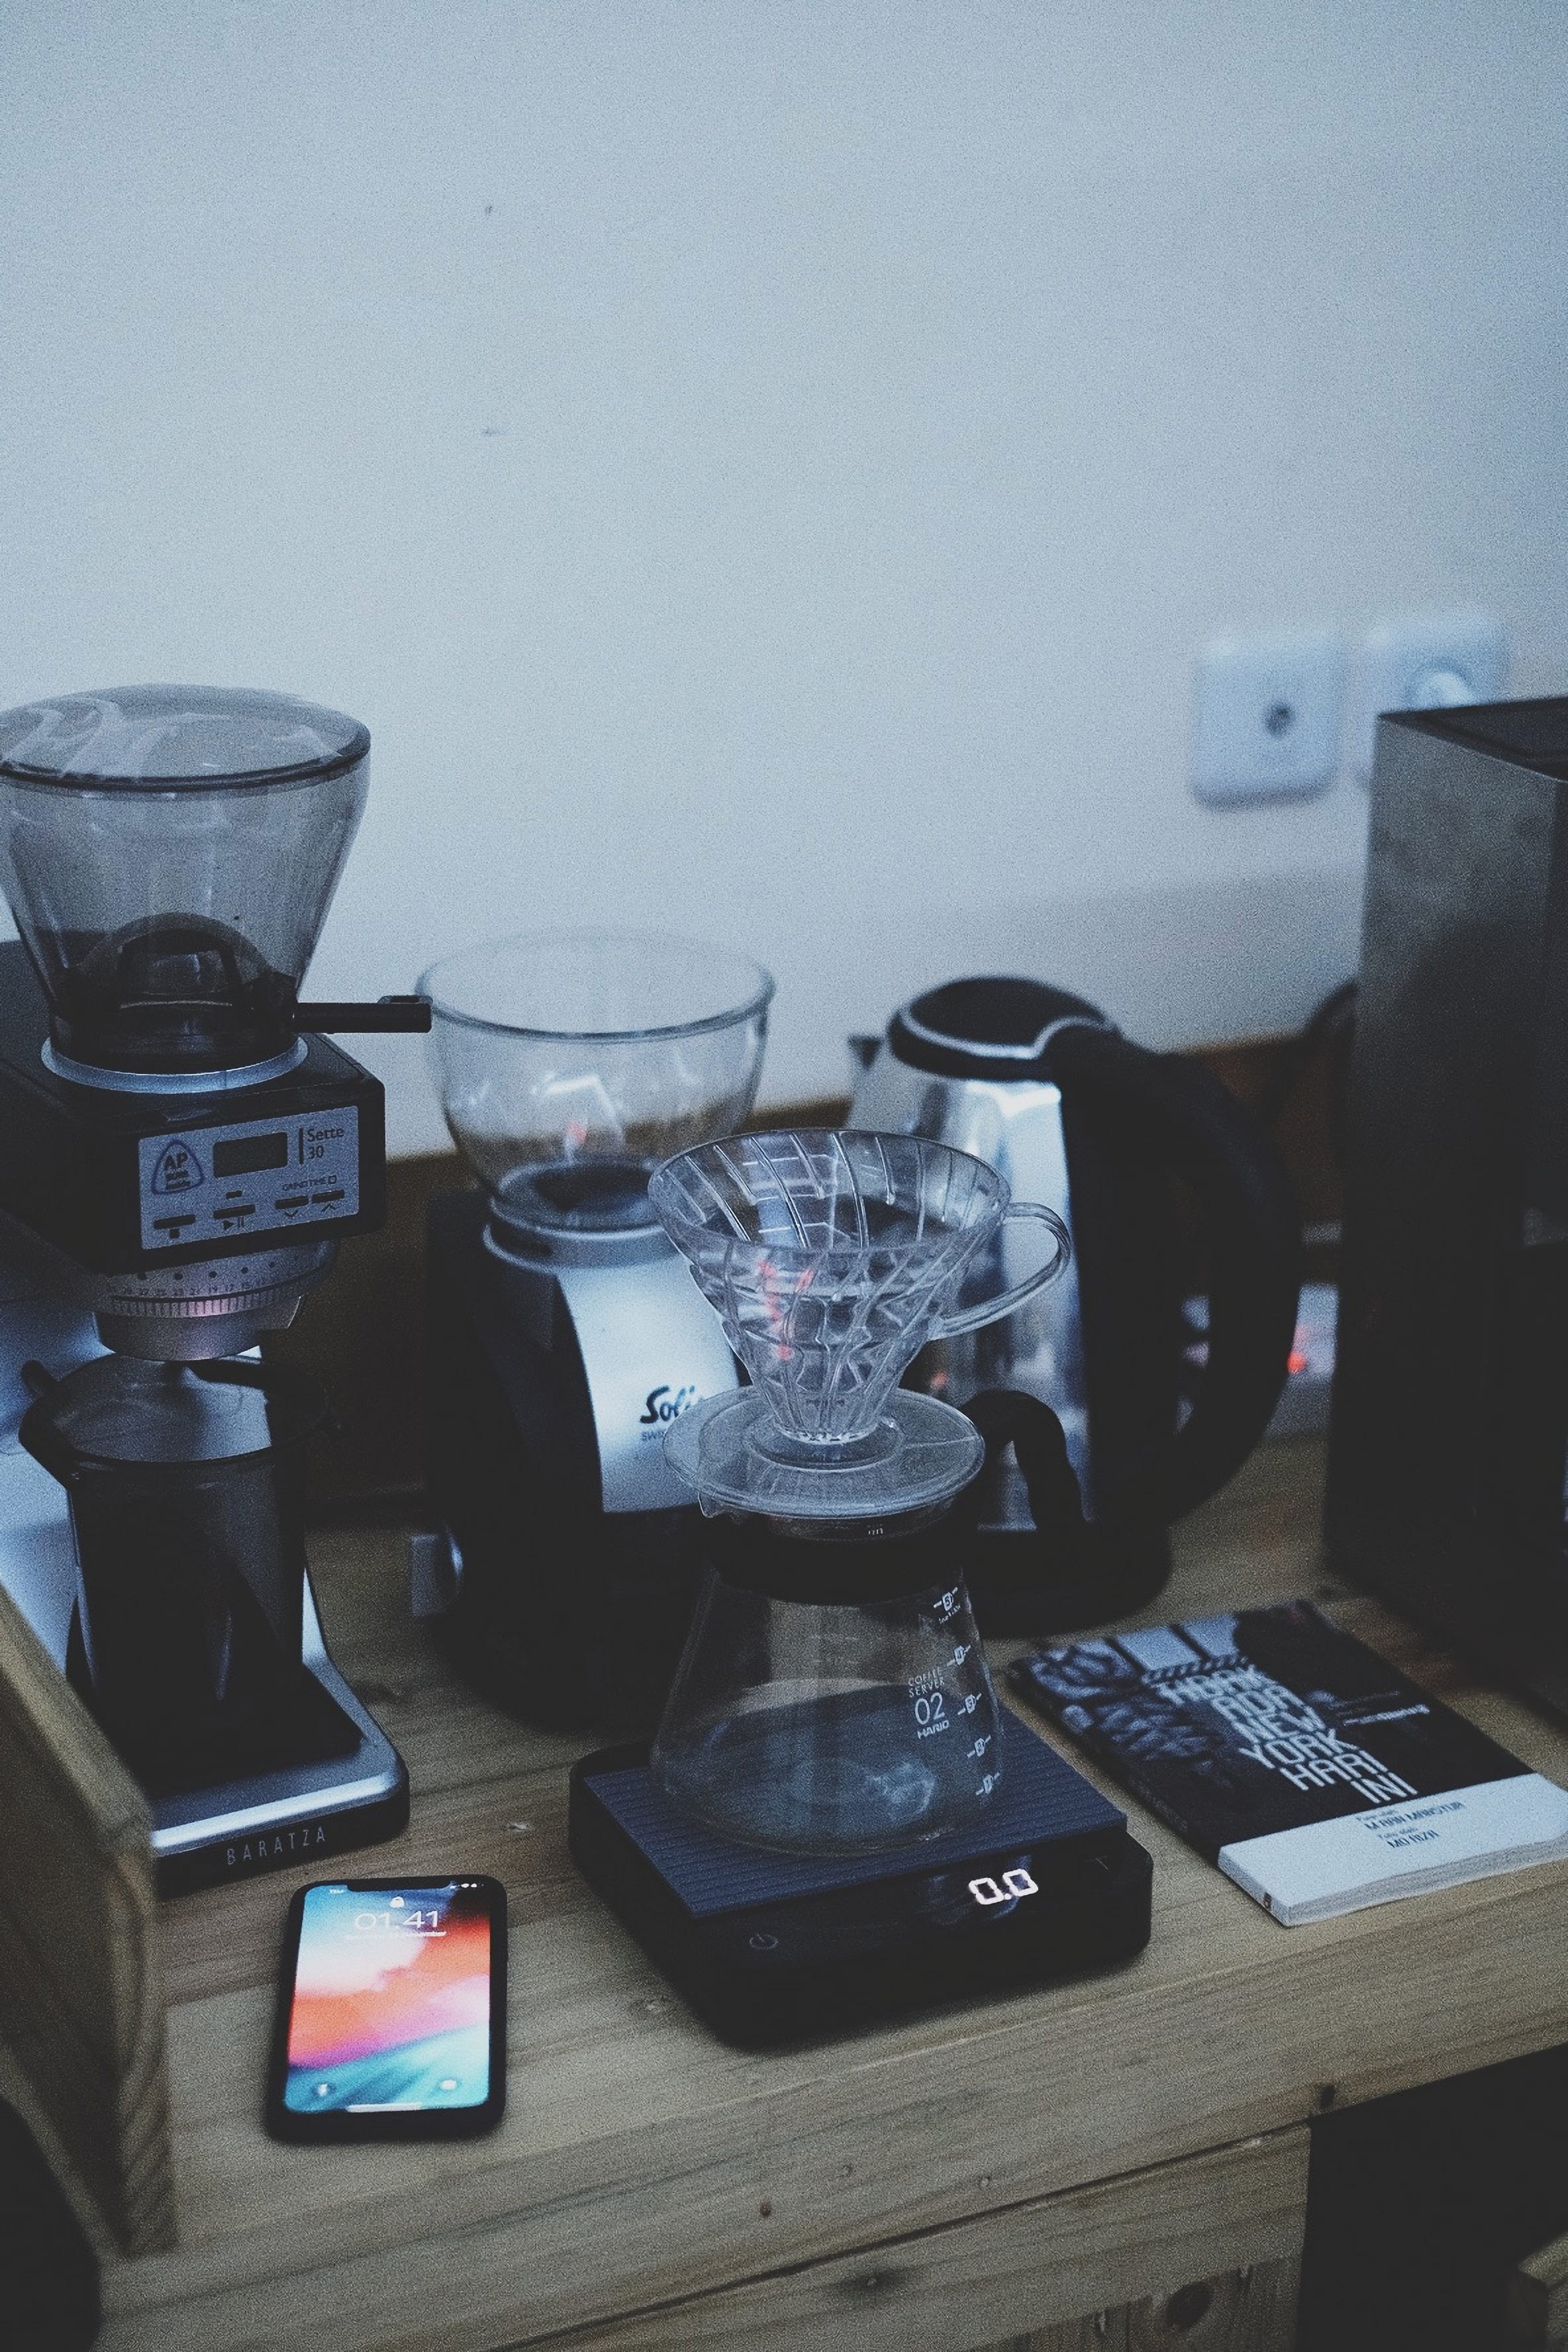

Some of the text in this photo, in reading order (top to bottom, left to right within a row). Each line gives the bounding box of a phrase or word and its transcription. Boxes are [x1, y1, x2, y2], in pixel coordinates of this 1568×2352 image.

[307, 1128, 344, 1142] Sette
[308, 1145, 324, 1159] 30
[164, 1152, 189, 1171] AP
[640, 1385, 699, 1424] Soli
[914, 1691, 946, 1726] 02
[1212, 1685, 1305, 1723] ADA
[917, 1719, 950, 1740] HARIO
[1231, 1705, 1325, 1744] NEW
[1238, 1728, 1359, 1769] YORK
[1279, 1749, 1389, 1791] HARI
[1350, 1771, 1418, 1804] INI
[226, 1826, 326, 1865] BARATZA
[968, 1868, 1039, 1906] 0.0
